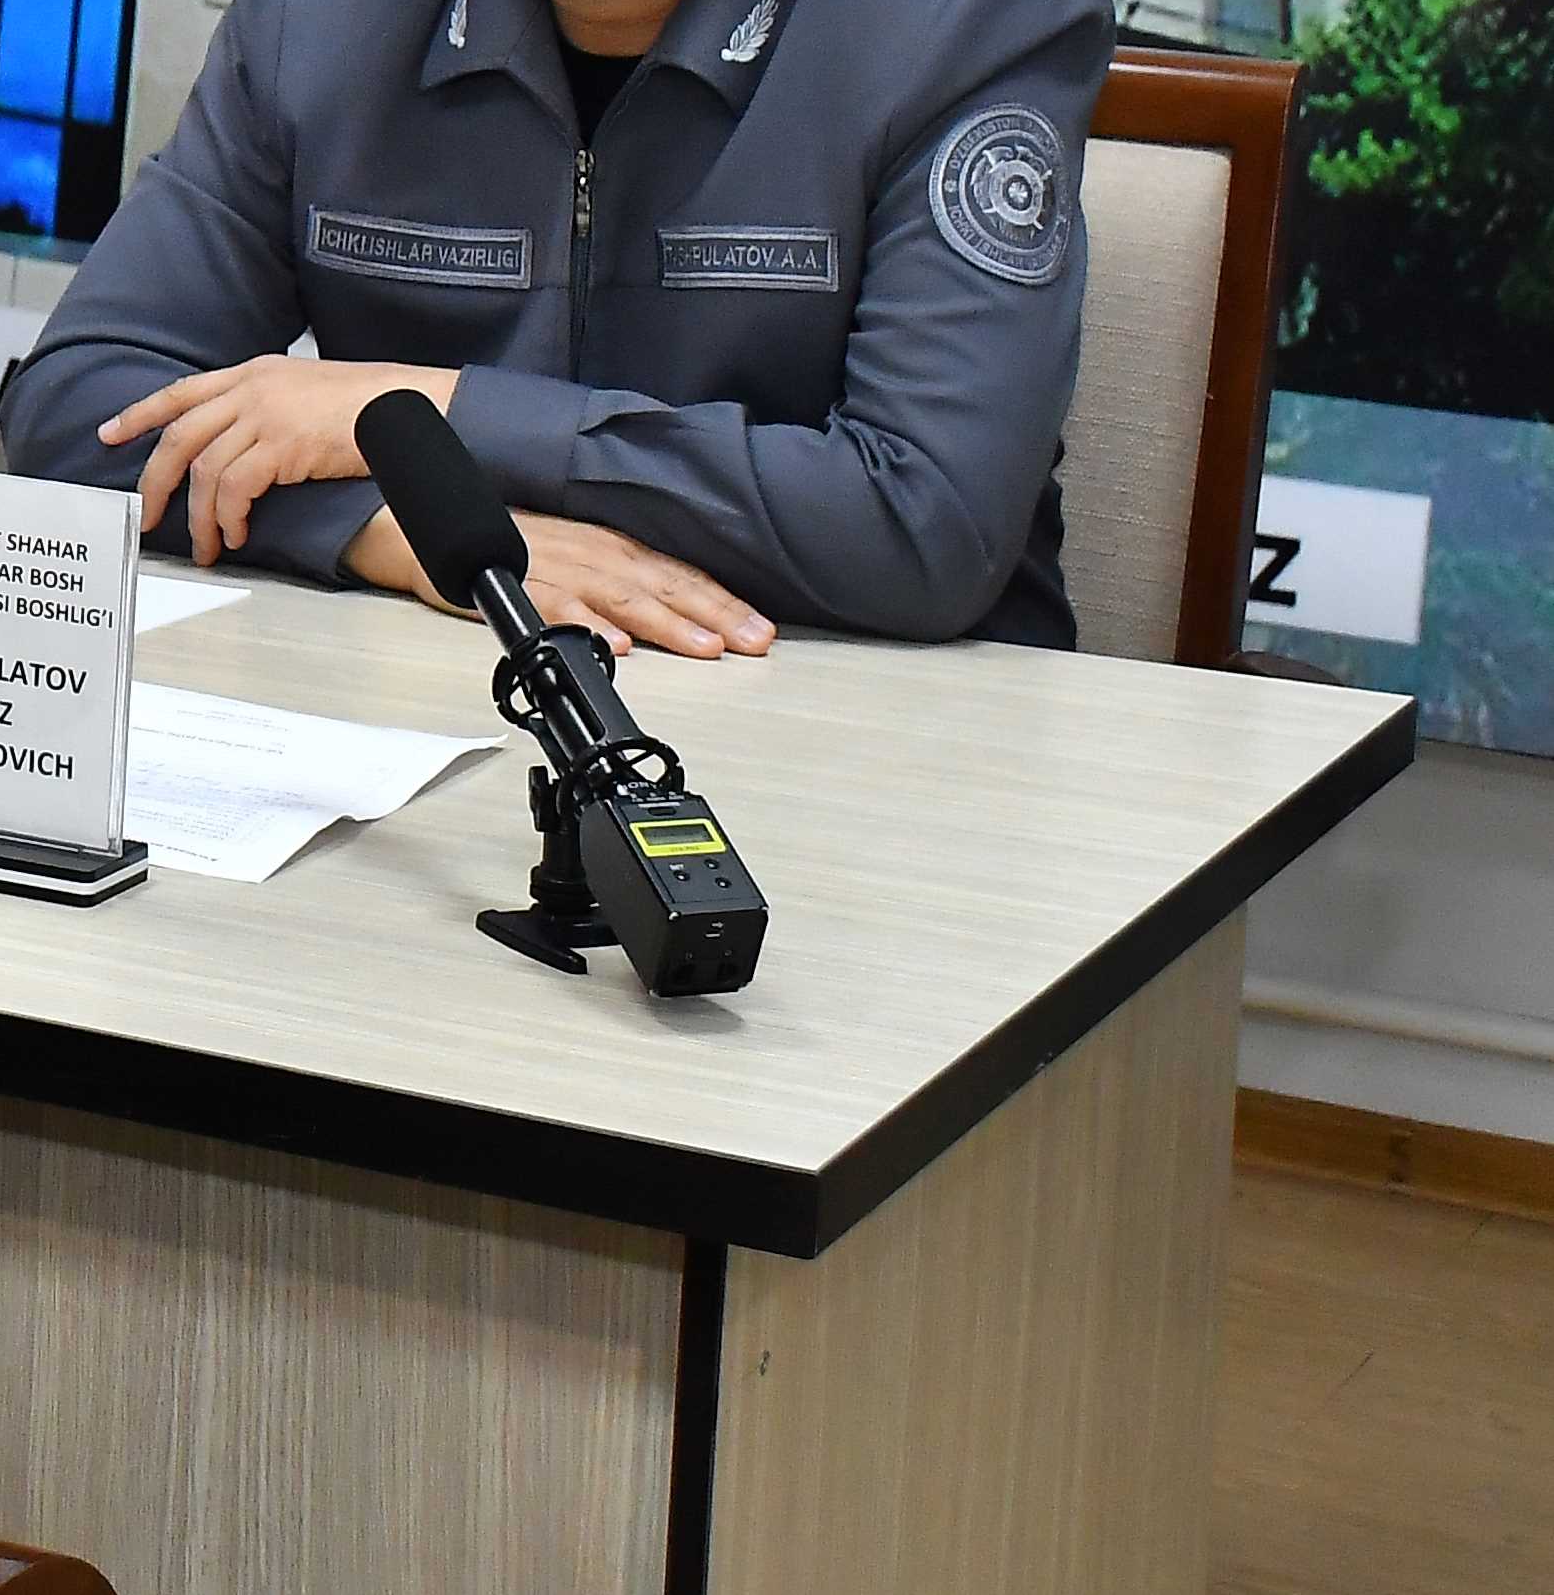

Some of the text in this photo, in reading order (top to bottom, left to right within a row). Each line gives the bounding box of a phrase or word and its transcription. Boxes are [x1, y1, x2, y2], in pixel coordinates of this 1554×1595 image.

[321, 226, 519, 269] ICHKI ISHLAR VAZIRLIGI
[6, 533, 89, 563] SHAHAR
[29, 567, 84, 593] BOSH
